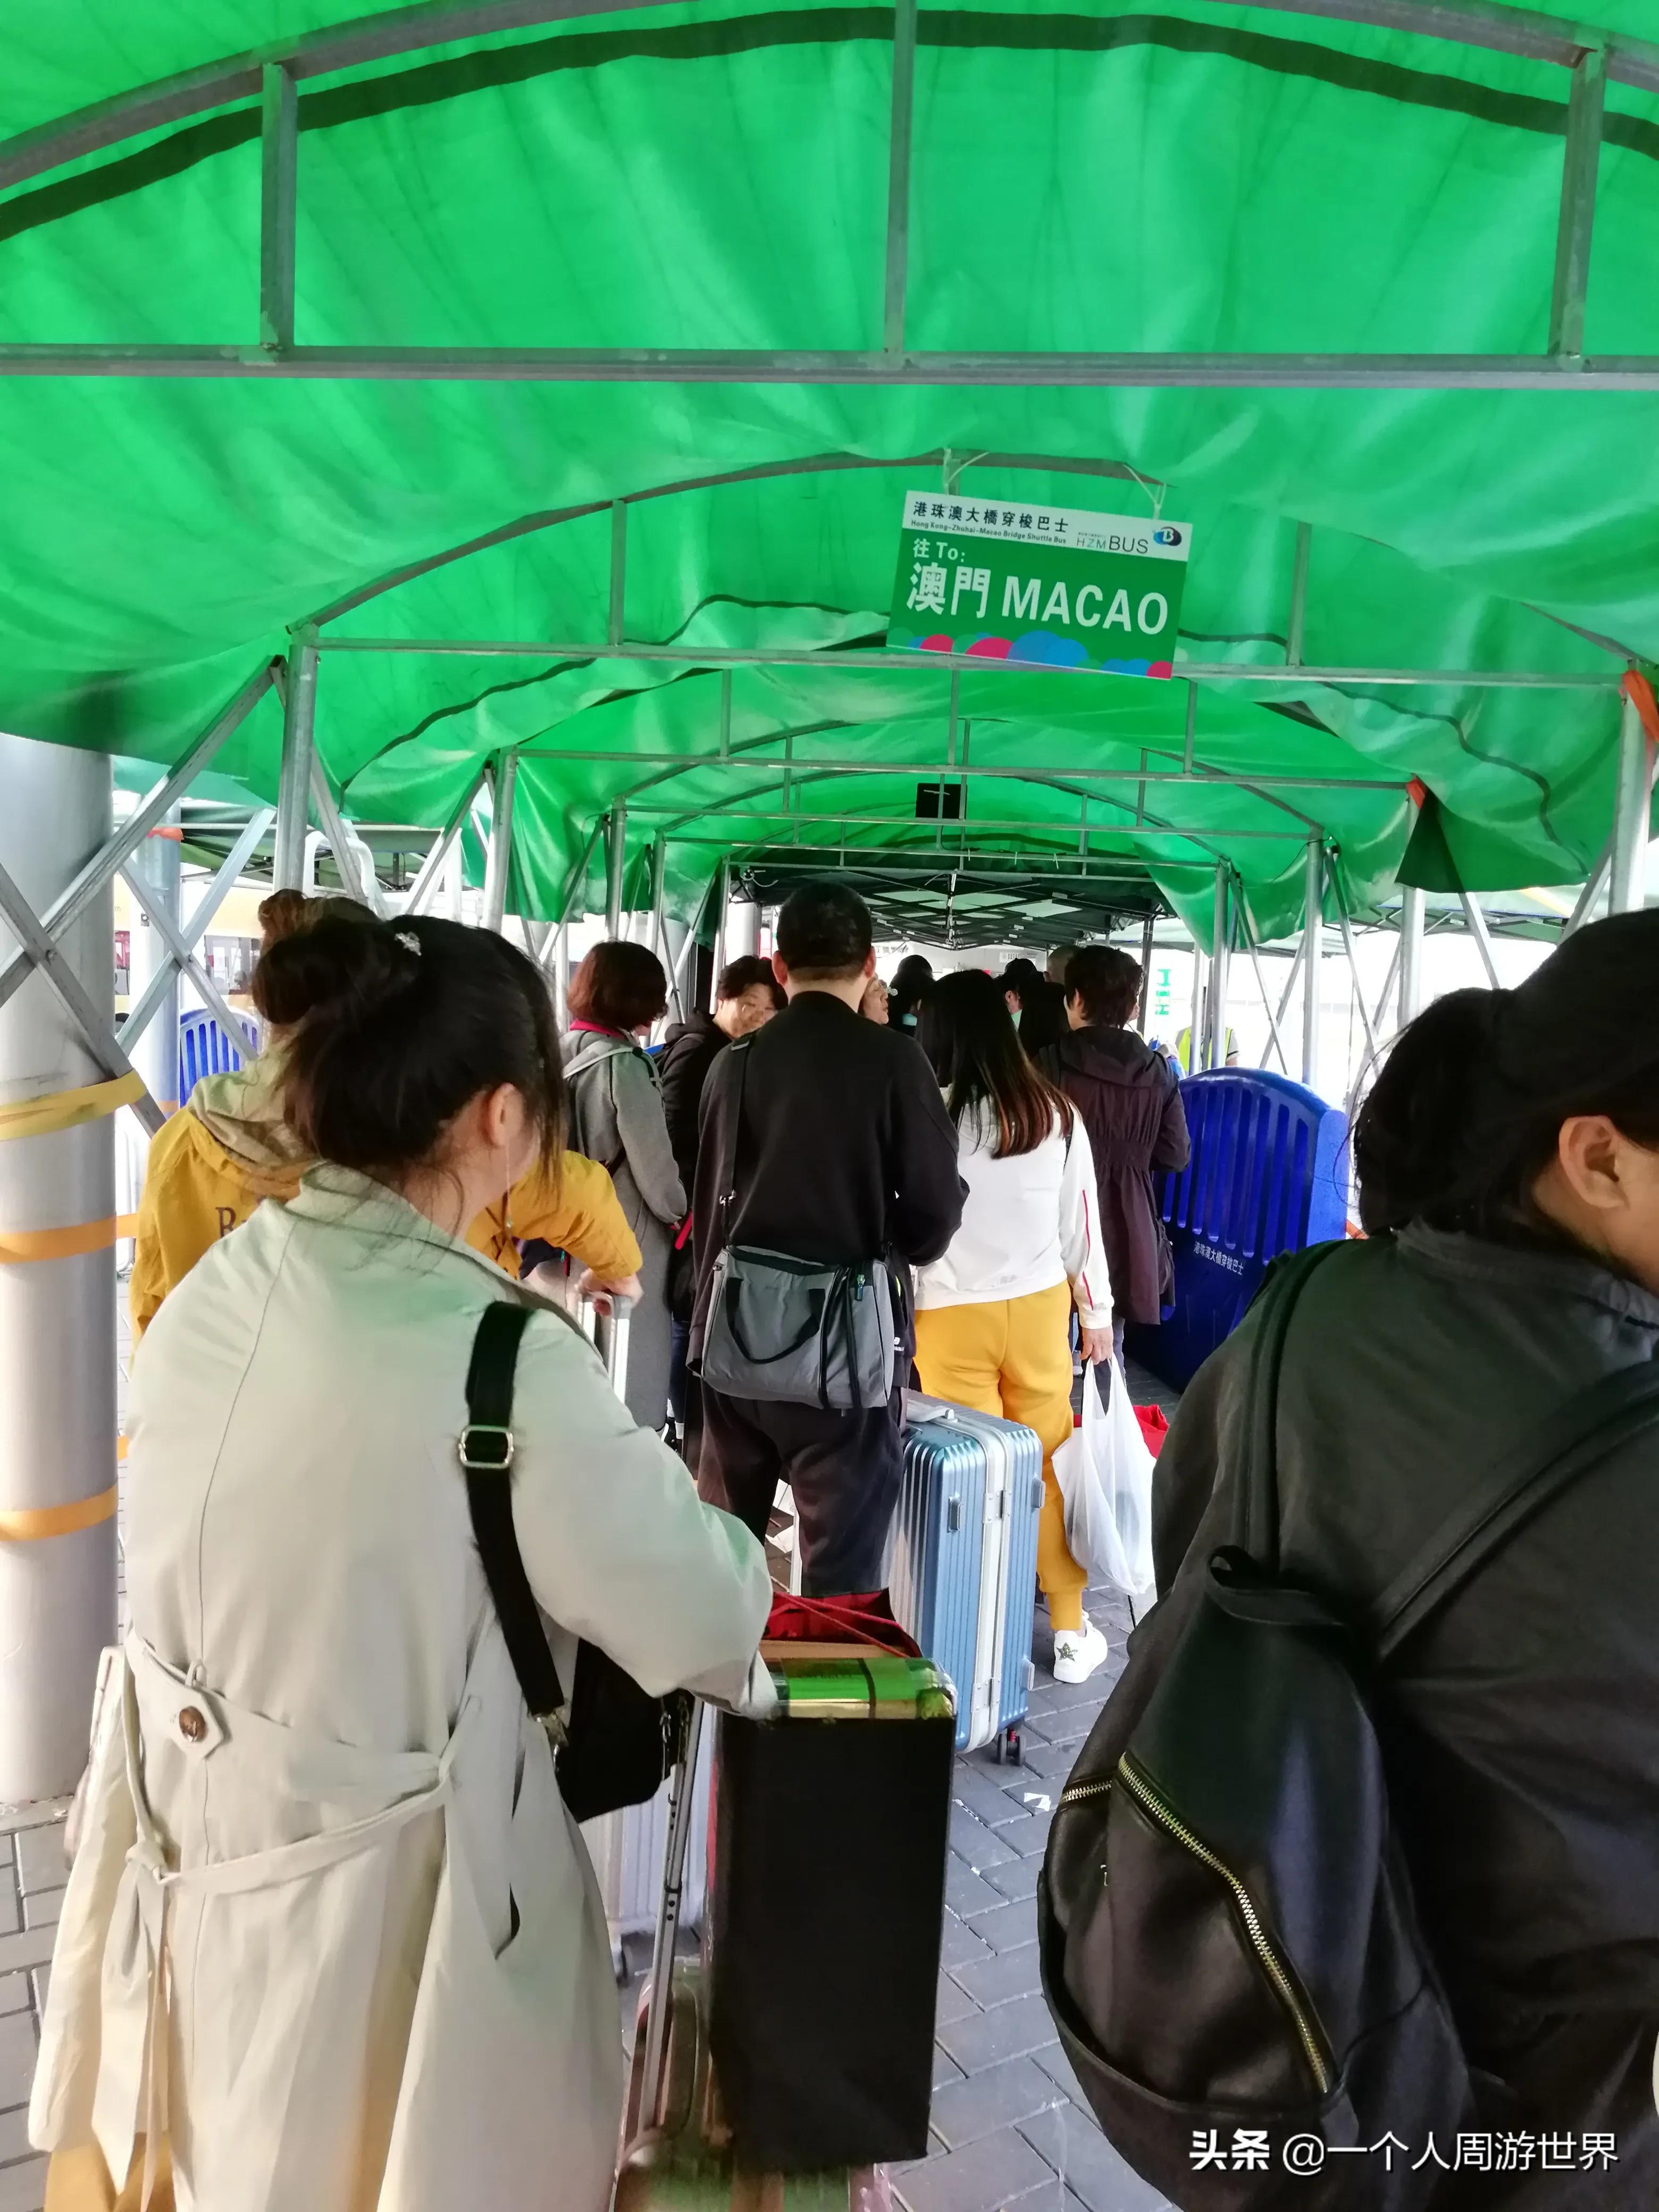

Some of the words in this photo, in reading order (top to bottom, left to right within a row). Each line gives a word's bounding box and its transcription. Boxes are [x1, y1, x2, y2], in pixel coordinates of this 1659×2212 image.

[911, 520, 928, 529] Hong
[1003, 530, 1026, 540] Bridge
[1027, 533, 1052, 542] Shuttle
[913, 501, 1068, 533] 港珠澳大橋穿梭巴士
[913, 538, 931, 558] 往
[936, 541, 965, 563] To:
[906, 562, 991, 618] 澳門
[1002, 575, 1168, 635] MACAO
